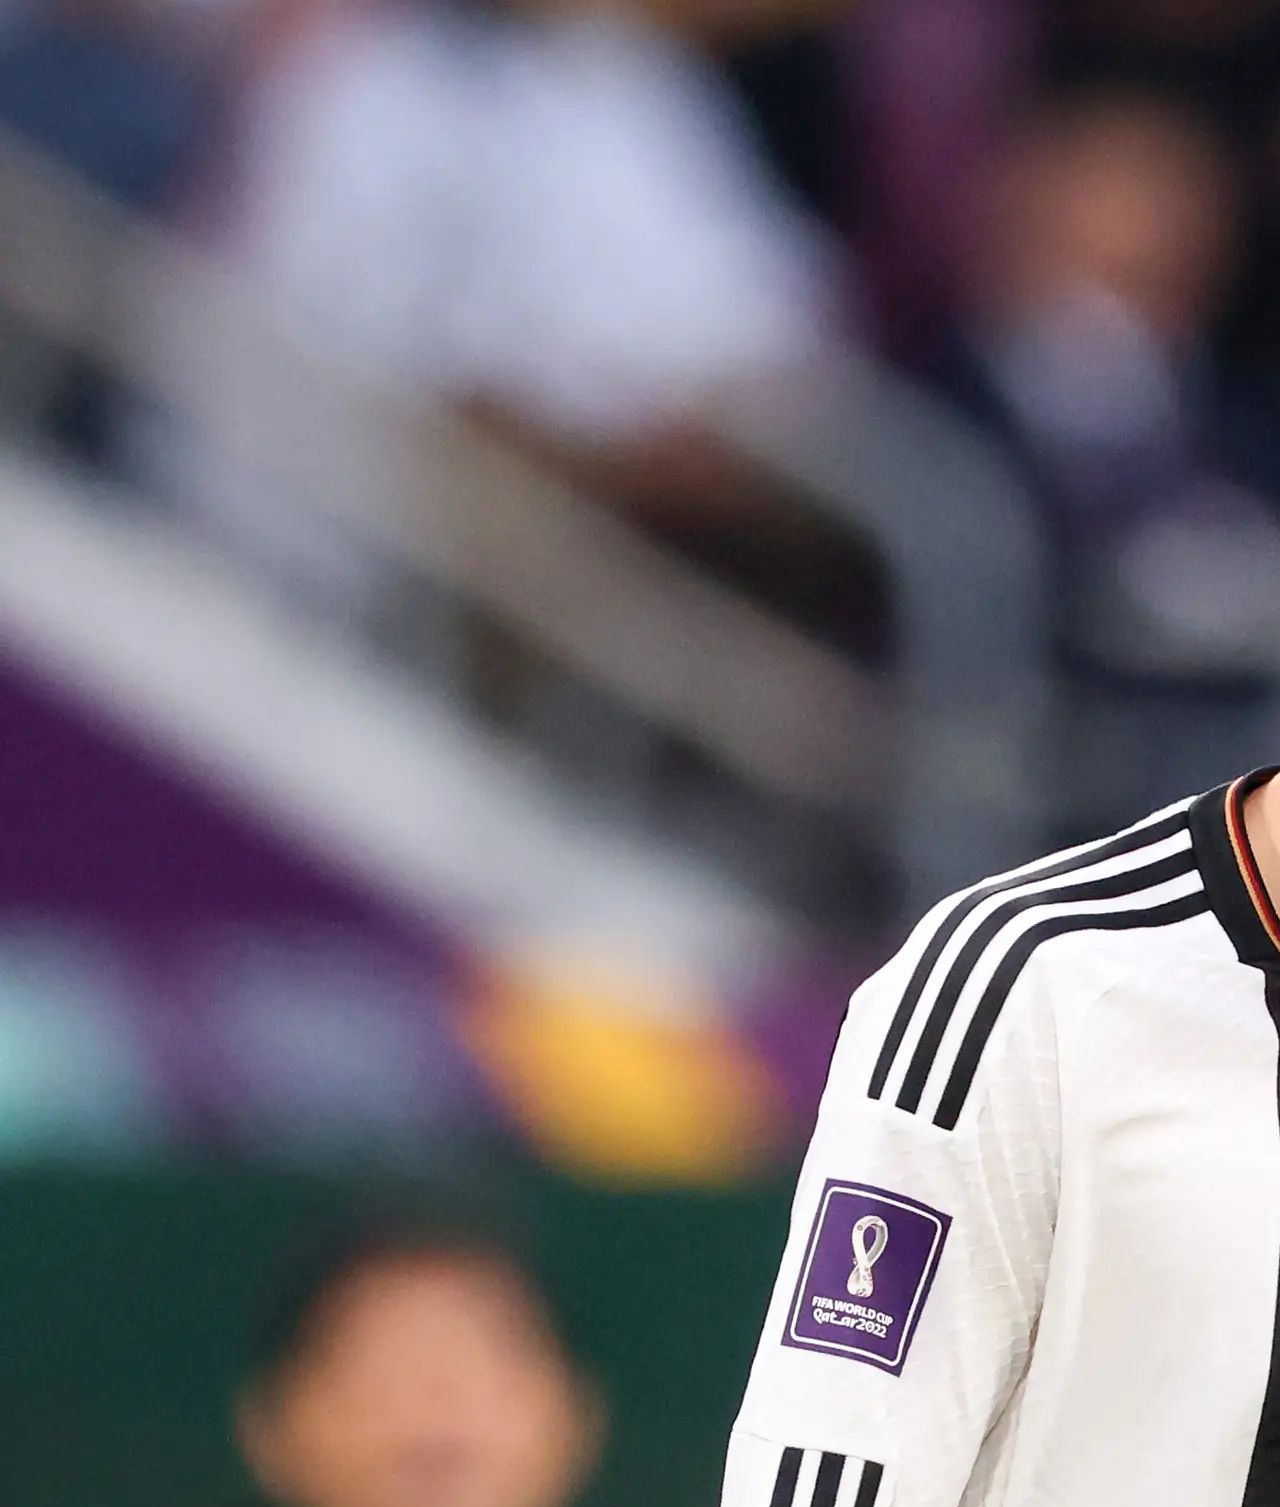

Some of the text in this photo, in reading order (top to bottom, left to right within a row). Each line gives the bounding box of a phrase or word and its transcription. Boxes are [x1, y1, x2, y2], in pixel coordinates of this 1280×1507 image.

[812, 1296, 894, 1326] FIFA WORLD CUP
[856, 1318, 888, 1338] 2022
